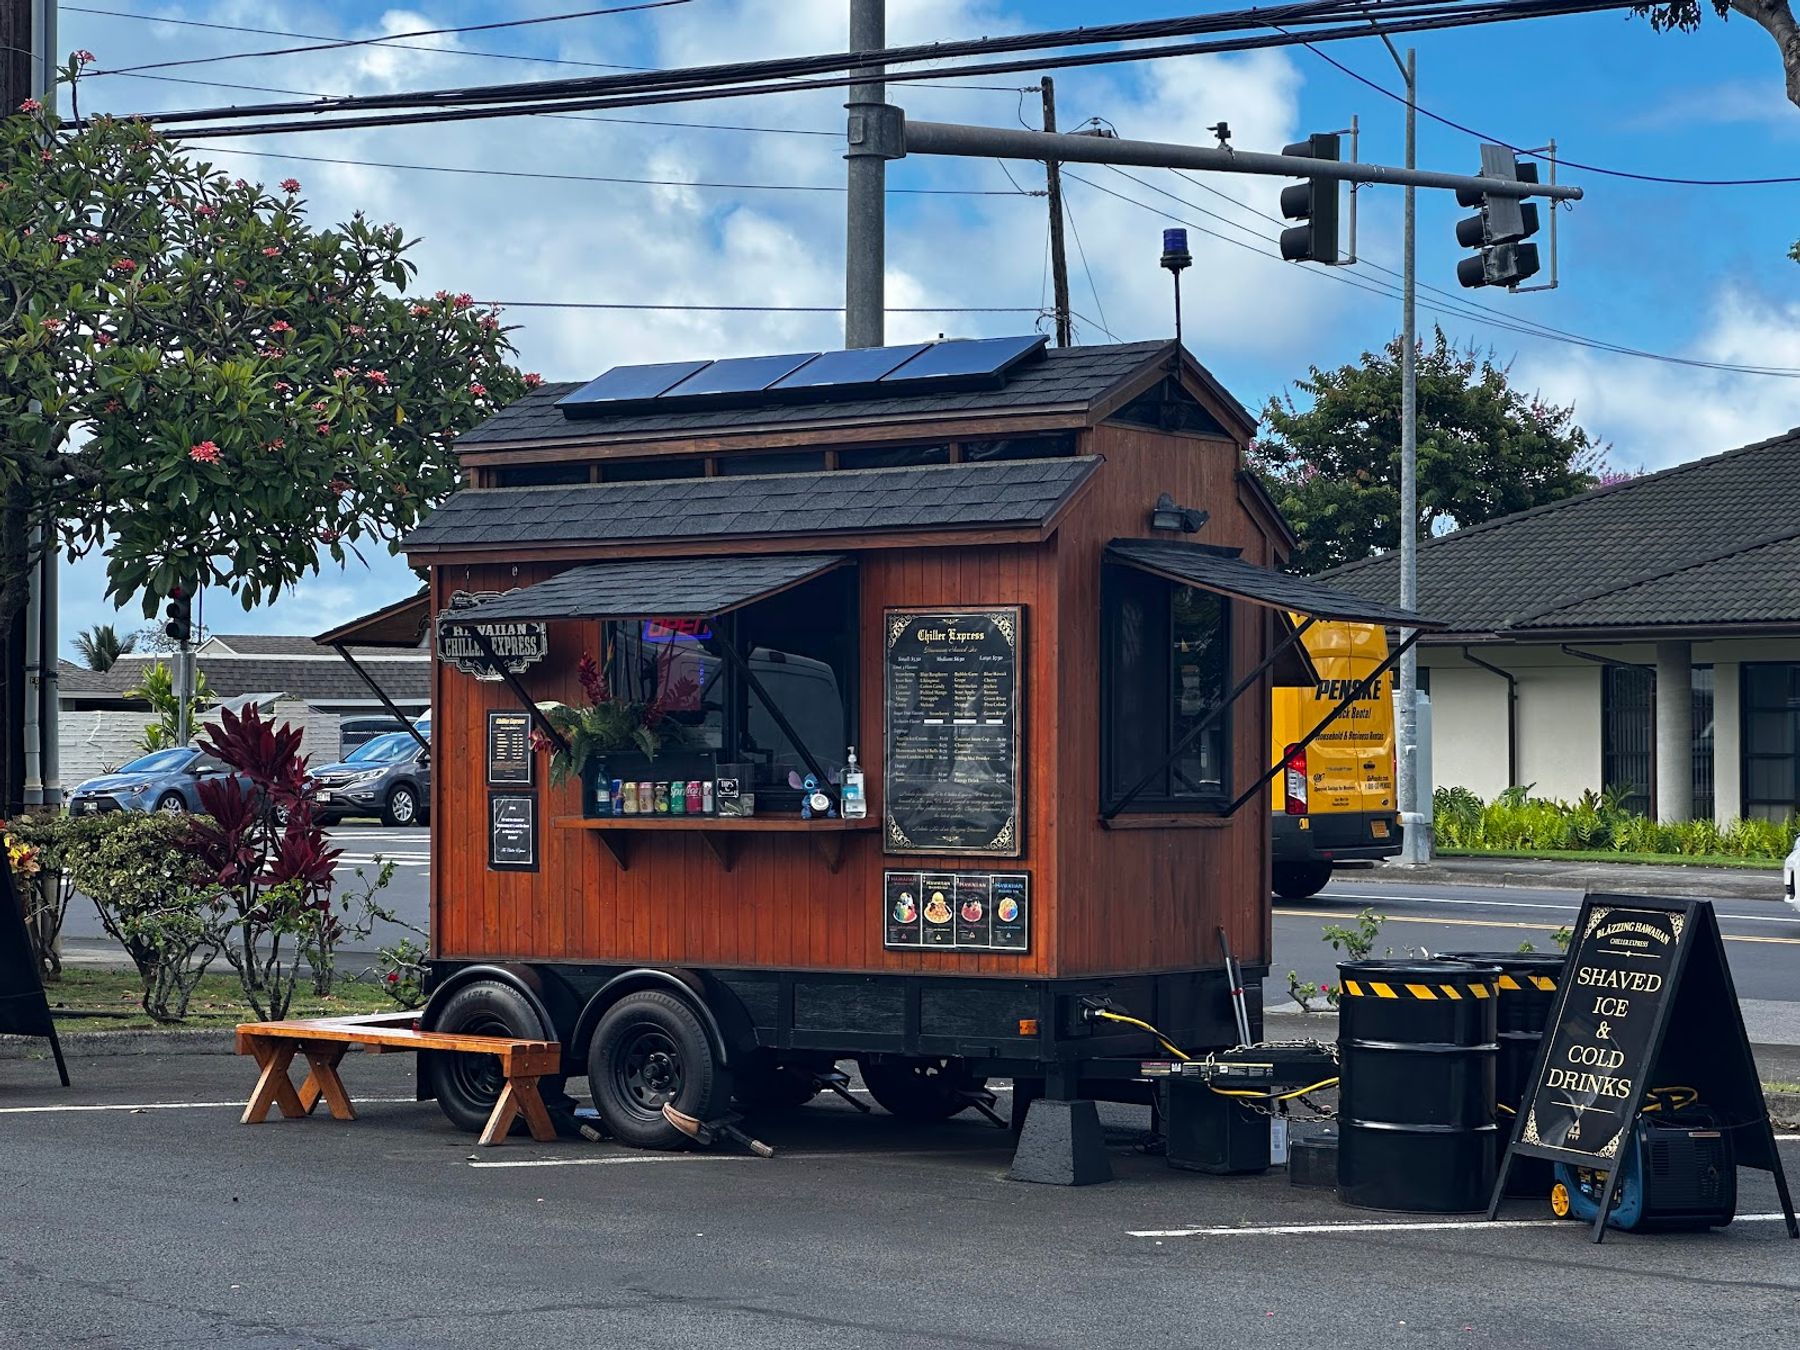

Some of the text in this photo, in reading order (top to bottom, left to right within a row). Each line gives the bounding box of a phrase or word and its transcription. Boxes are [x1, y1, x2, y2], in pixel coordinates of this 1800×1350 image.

[453, 624, 527, 636] HAIIAN
[648, 616, 709, 637] OPEN
[917, 628, 985, 644] Chiller Express
[445, 636, 537, 657] CHILL EXPRESS
[1596, 922, 1671, 945] BLAZZING HAWAIIAN
[1578, 967, 1662, 993] SHAVED
[1592, 997, 1629, 1017] ICE
[1595, 1021, 1611, 1039] &
[1568, 1045, 1624, 1069] COLD
[1546, 1068, 1631, 1099] DRINKS
